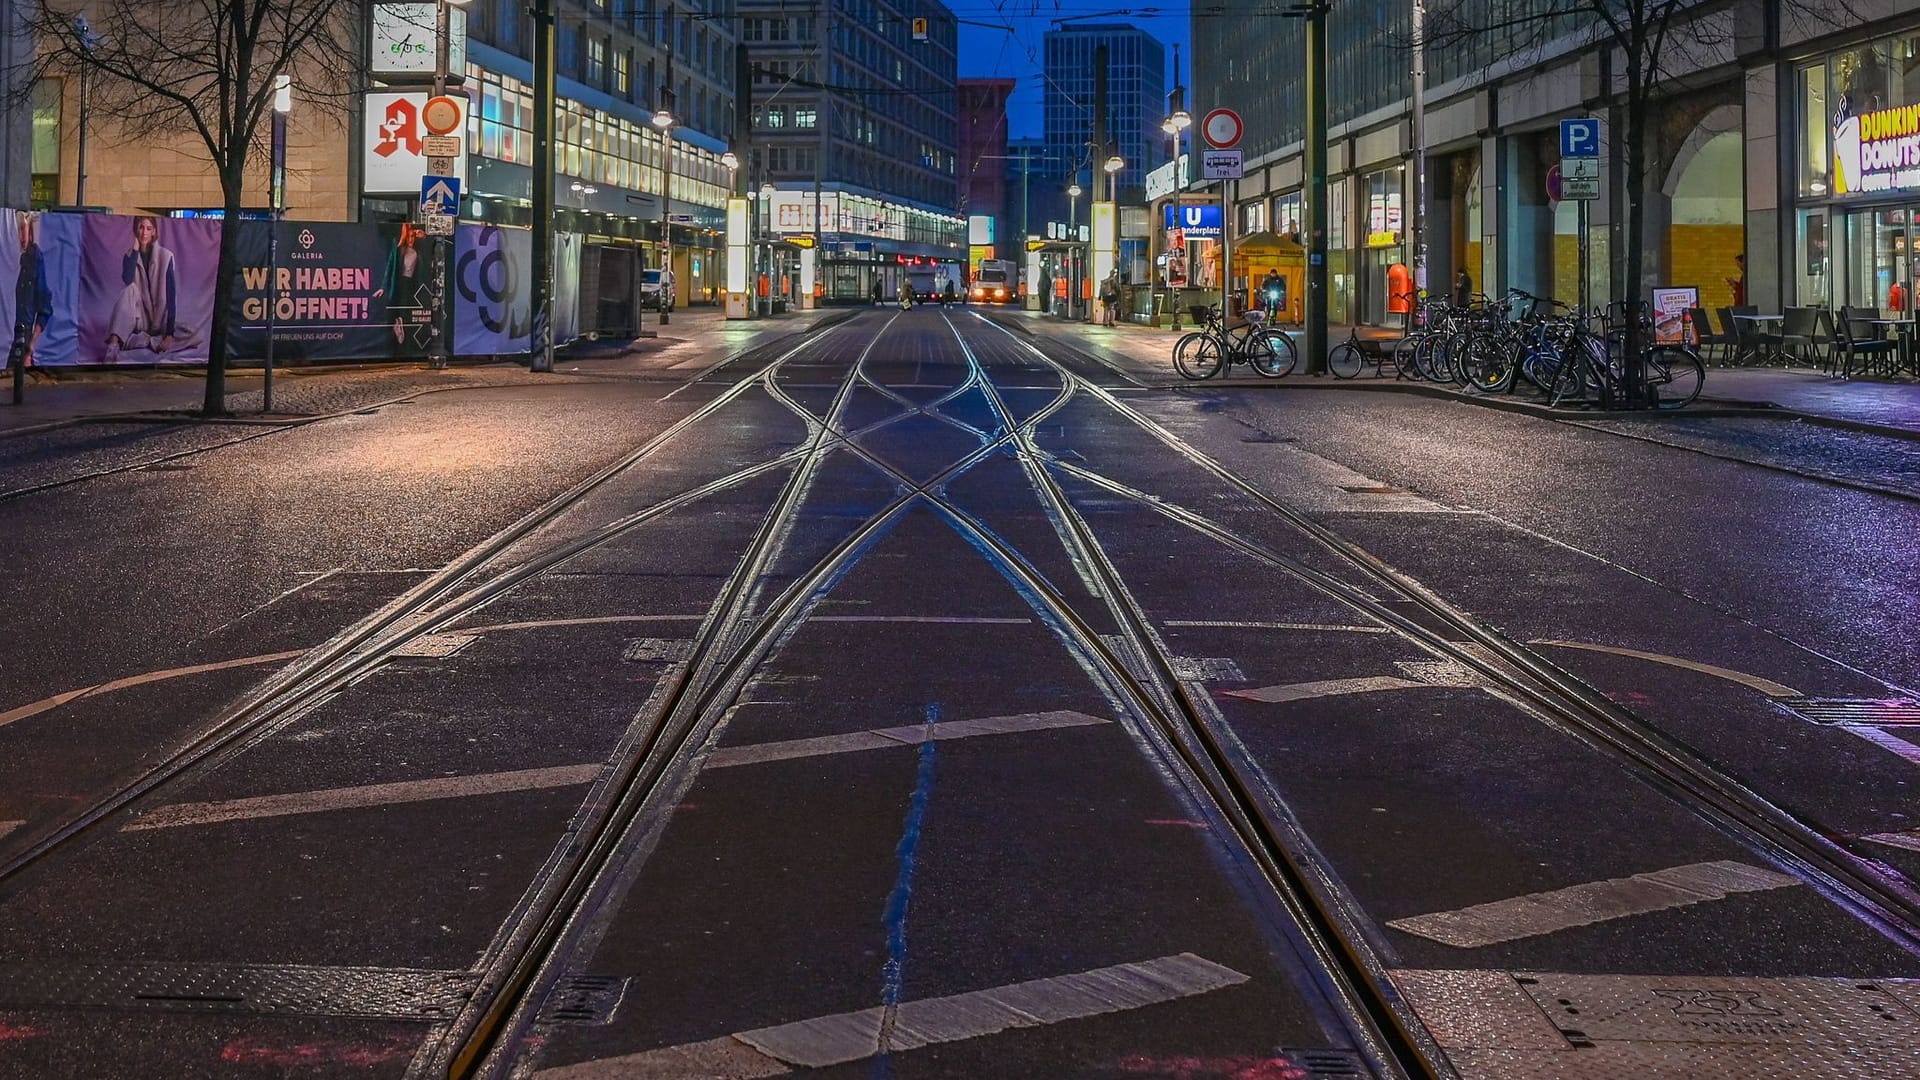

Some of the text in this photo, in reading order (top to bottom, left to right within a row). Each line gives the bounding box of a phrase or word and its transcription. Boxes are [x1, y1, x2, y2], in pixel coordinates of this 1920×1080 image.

[1569, 124, 1590, 153] P
[1861, 135, 1920, 171] DONUTS
[1216, 168, 1230, 176] frei
[1186, 207, 1202, 226] U
[291, 252, 323, 260] GALERIA
[242, 267, 370, 290] WR HABEN
